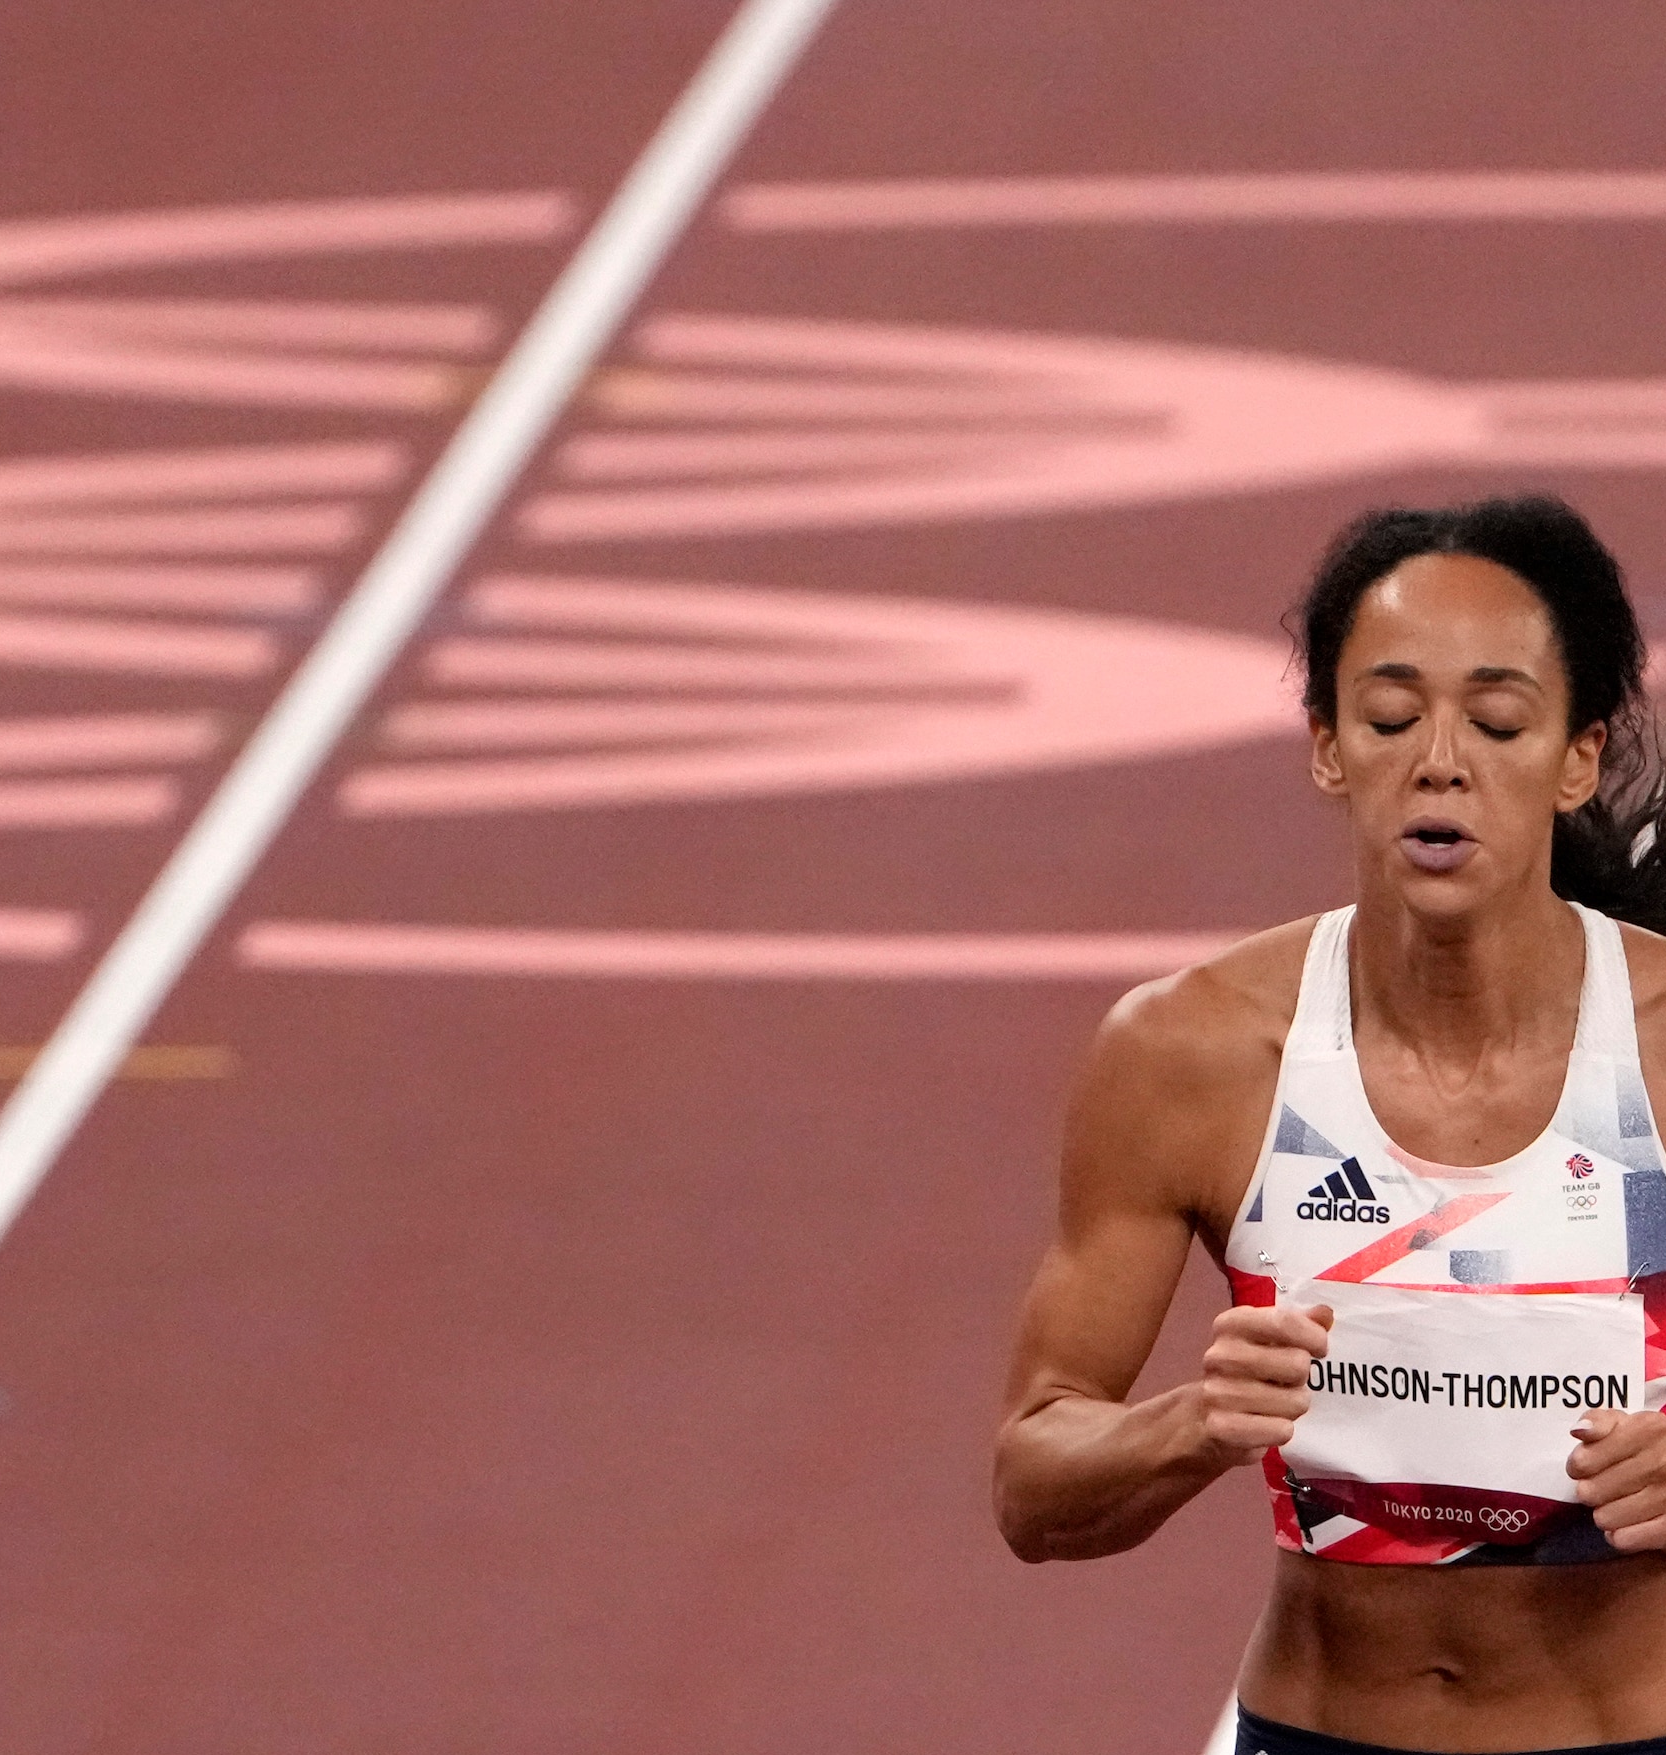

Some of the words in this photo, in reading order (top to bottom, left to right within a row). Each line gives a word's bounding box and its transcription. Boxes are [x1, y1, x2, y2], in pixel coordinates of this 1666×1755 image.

[1562, 1184, 1585, 1193] TEAM
[1587, 1182, 1601, 1190] GB
[1296, 1198, 1390, 1224] adidas
[1306, 1359, 1628, 1409] OHNSON-THOMPSON
[1383, 1500, 1431, 1520] TOKYO
[1434, 1507, 1473, 1524] 2020
